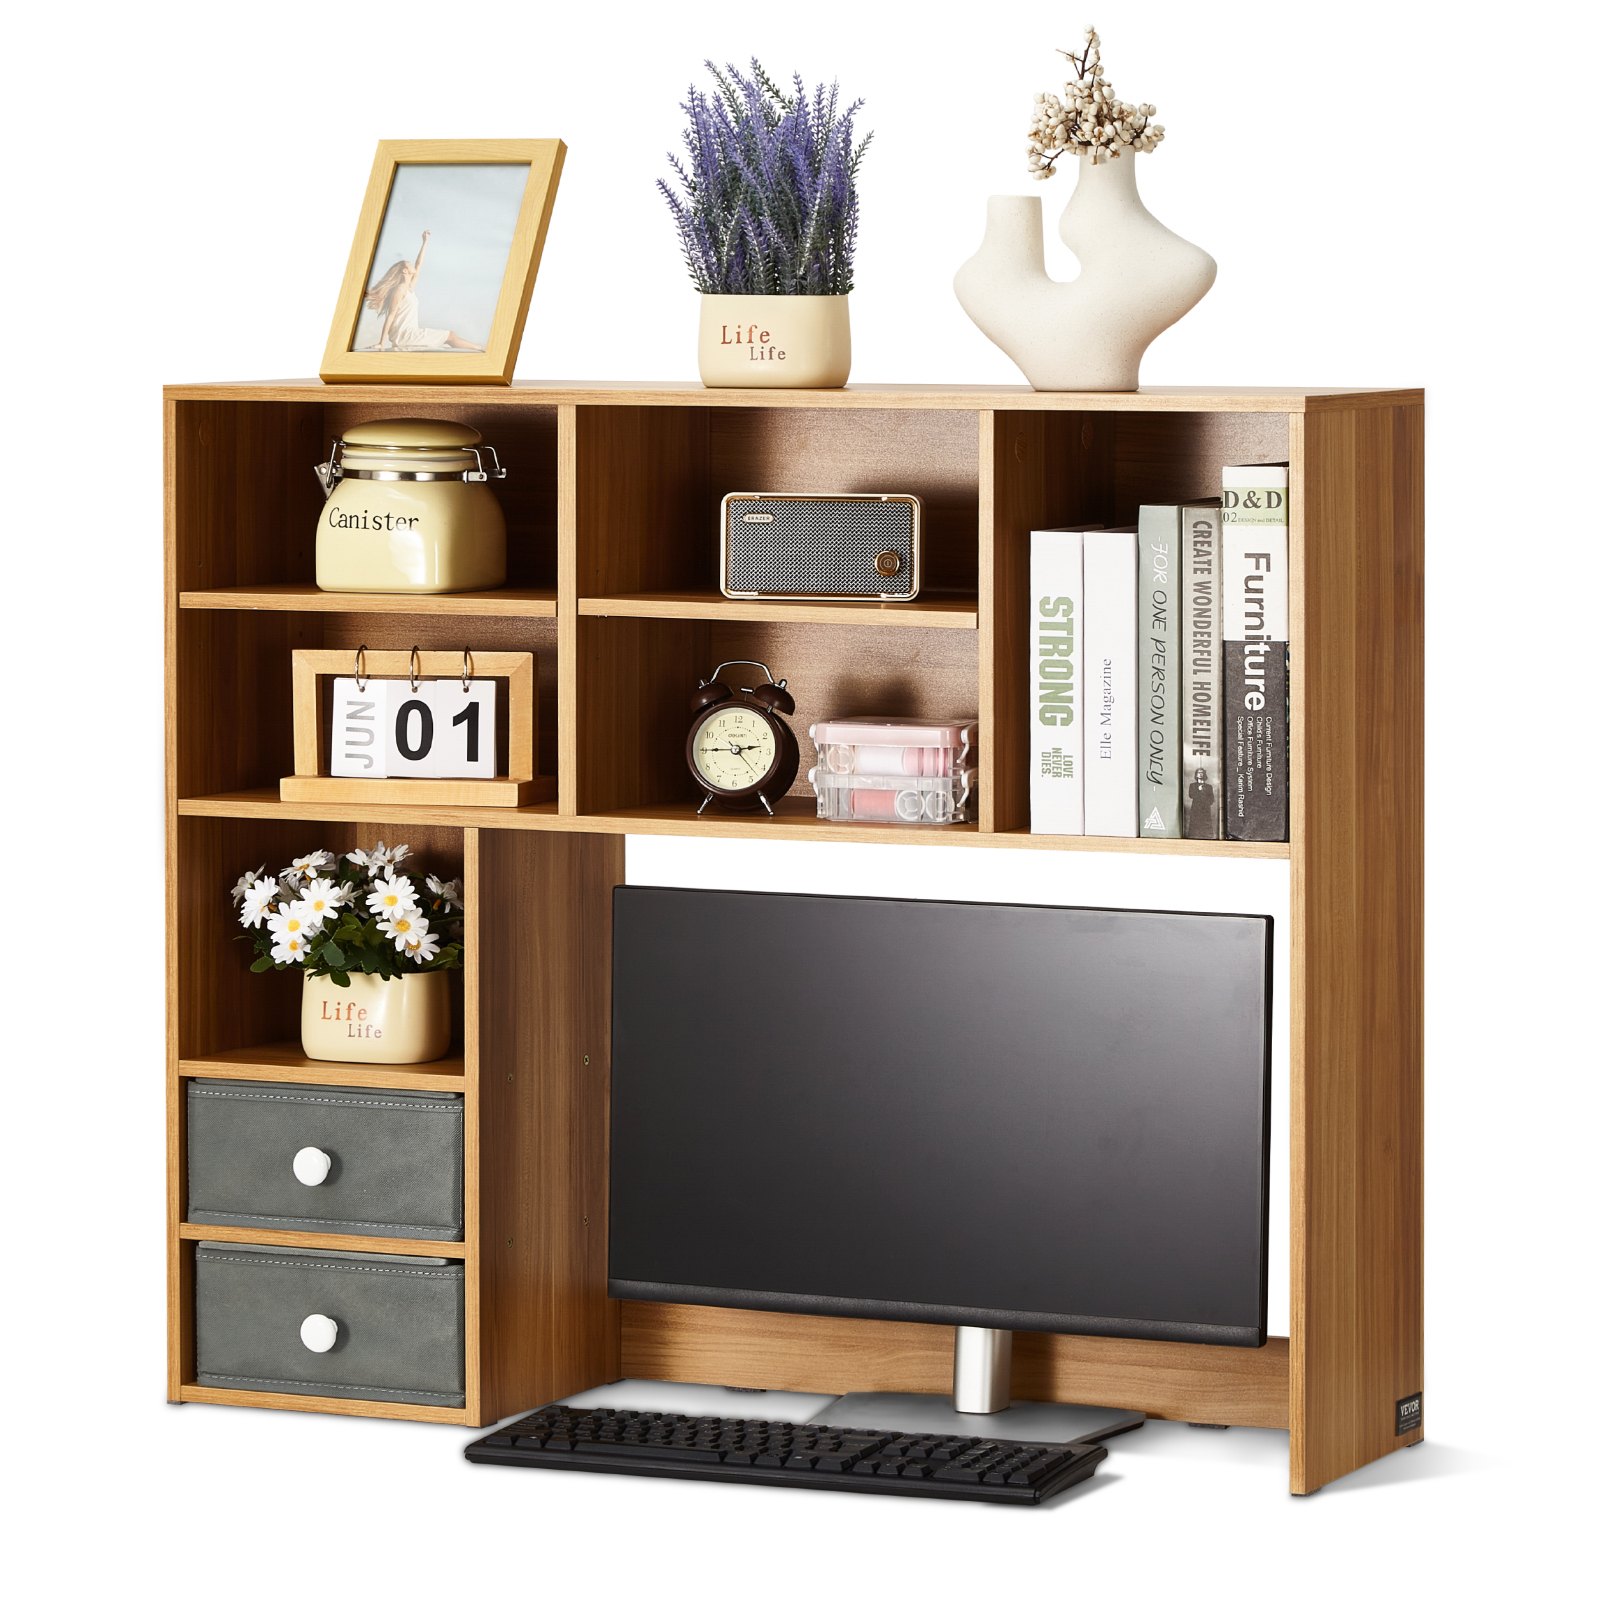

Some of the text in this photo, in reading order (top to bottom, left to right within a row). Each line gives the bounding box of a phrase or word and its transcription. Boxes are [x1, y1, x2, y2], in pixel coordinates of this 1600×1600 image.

[720, 324, 770, 345] Life
[750, 346, 786, 361] Life
[329, 507, 420, 531] Canister
[1223, 511, 1238, 523] 02
[1152, 590, 1168, 632] ONE
[1192, 520, 1213, 757] CREATE WONDERFUL HOMELIFE
[1243, 552, 1272, 711] Furniture
[1039, 596, 1074, 727] STRONG
[1150, 637, 1167, 725] PERSON
[734, 715, 743, 724] 12
[1099, 658, 1115, 760] Elle Magazine
[718, 719, 726, 728] 11
[1236, 716, 1244, 741] Special
[345, 700, 376, 769] JUN
[705, 731, 714, 739] 10
[762, 732, 768, 740] 2
[766, 748, 771, 756] 3
[1051, 747, 1063, 778] NEVER
[1237, 741, 1245, 767] Feature
[1264, 716, 1273, 796] Current Furniture Design
[705, 763, 711, 771] 8
[761, 764, 766, 772] 4
[1041, 751, 1052, 778] DIES.
[1062, 755, 1074, 779] LOVE
[716, 775, 722, 783] 7
[732, 780, 738, 788] 6
[748, 775, 754, 783] 5
[1237, 773, 1245, 793] Karim
[1245, 767, 1254, 792] System
[1237, 794, 1245, 818] Rashid
[321, 1000, 367, 1021] Life
[347, 1023, 382, 1039] Life
[1400, 1399, 1420, 1417] VEVOR
